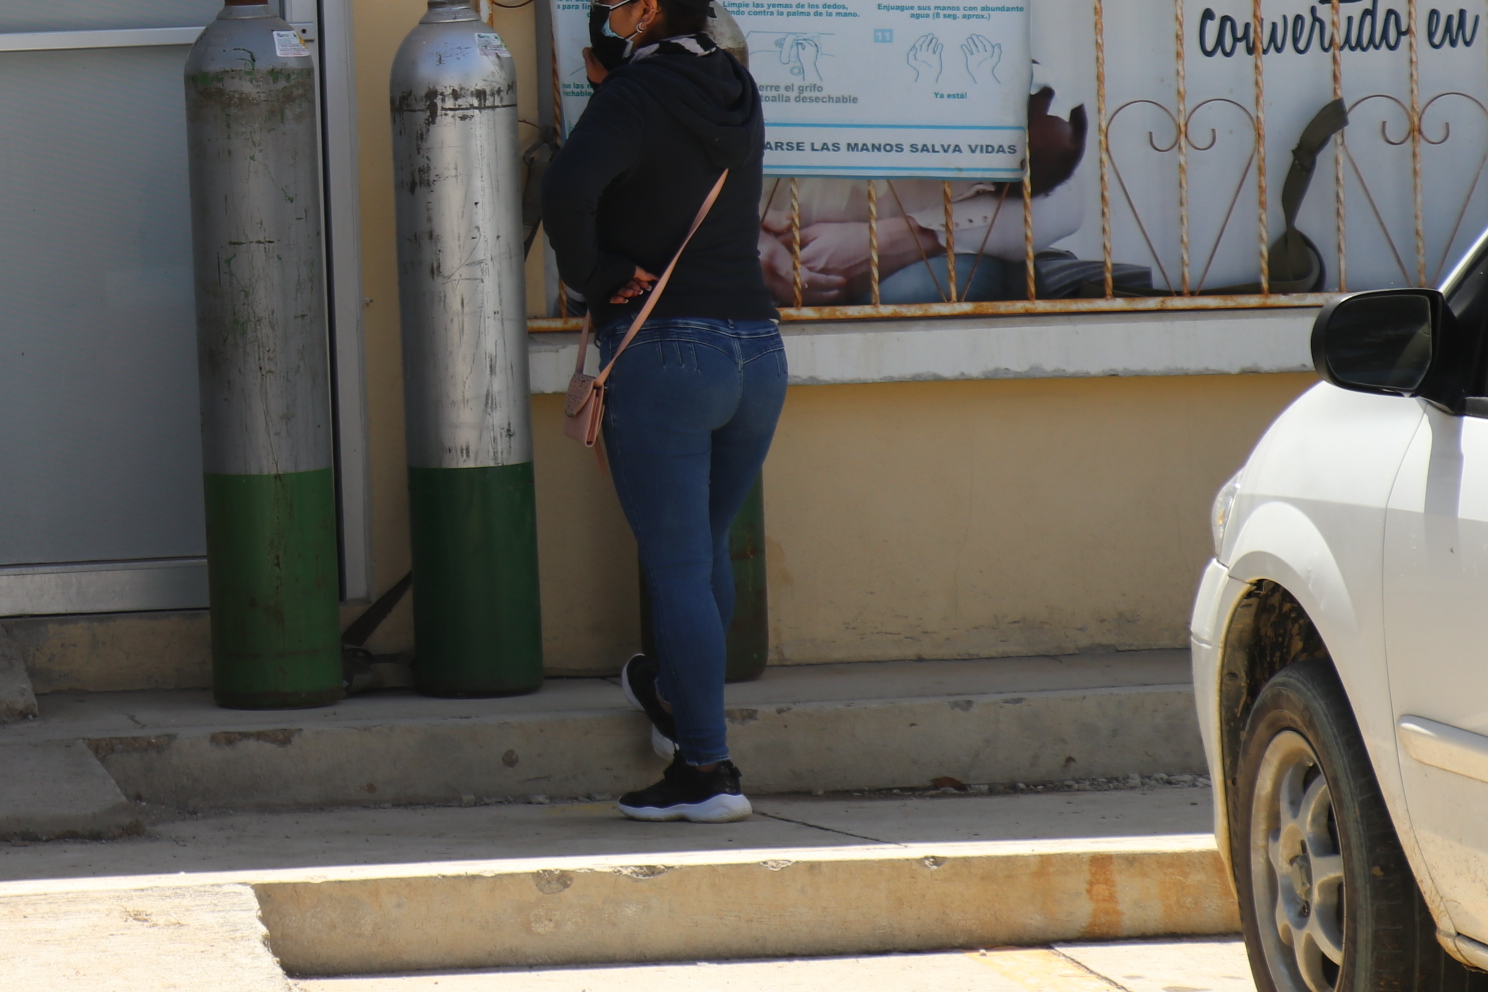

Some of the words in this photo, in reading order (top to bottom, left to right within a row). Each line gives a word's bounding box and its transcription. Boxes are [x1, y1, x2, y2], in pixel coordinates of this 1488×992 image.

[1427, 8, 1480, 49] en
[785, 84, 794, 92] el
[798, 84, 823, 94] grifo
[795, 95, 858, 103] desechable
[811, 142, 841, 152] LAS
[846, 143, 904, 153] MANOS
[910, 143, 963, 154] SALVA
[968, 144, 1017, 154] VIDAS
